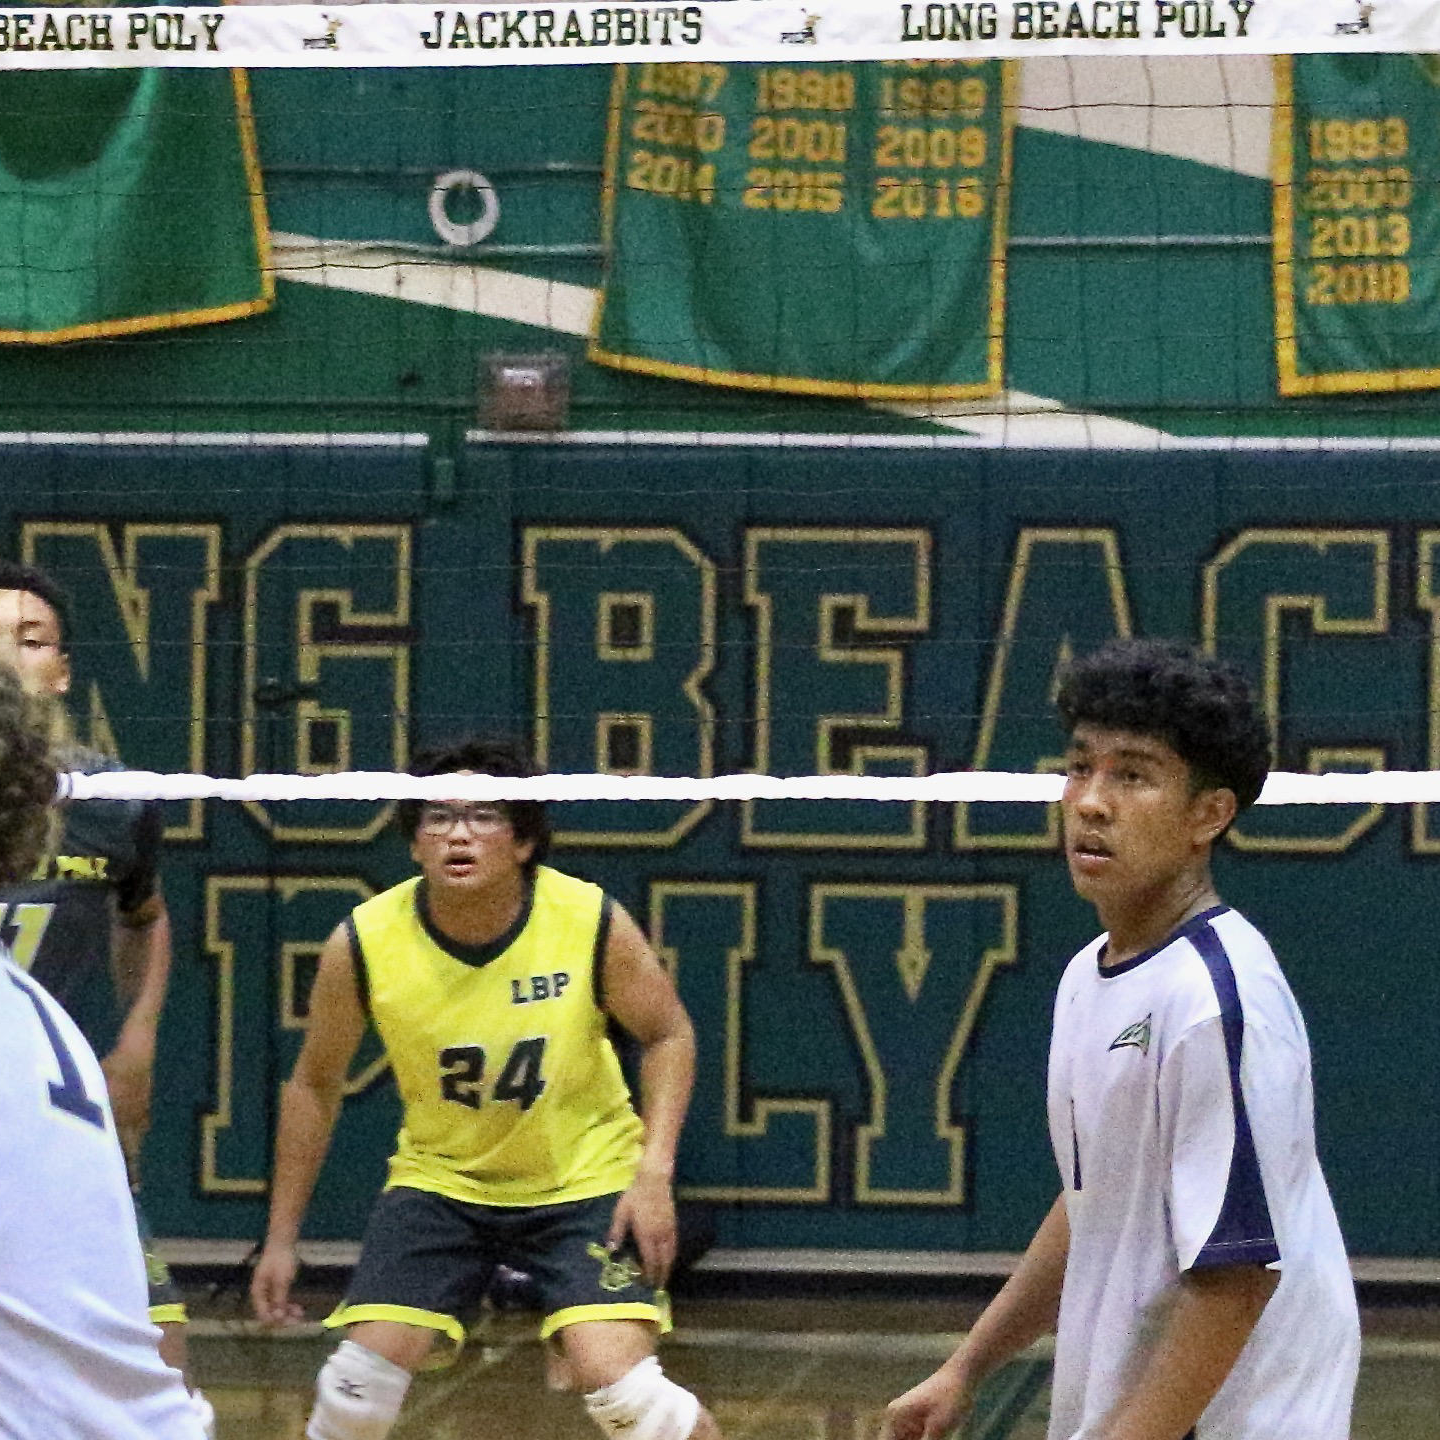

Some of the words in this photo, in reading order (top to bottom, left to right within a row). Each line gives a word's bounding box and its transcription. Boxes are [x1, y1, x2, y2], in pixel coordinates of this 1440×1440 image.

[126, 12, 224, 52] POLY
[419, 7, 702, 50] JACKRABBITS
[900, 3, 998, 42] LONG
[1011, 1, 1140, 41] BEACH
[1153, 0, 1255, 39] POLY
[871, 177, 987, 220] 2016
[1308, 212, 1413, 258] 2013
[520, 525, 1440, 855] BEAC
[510, 971, 571, 1005] LBP
[200, 874, 1019, 1207] PLY
[437, 1033, 549, 1112] 24
